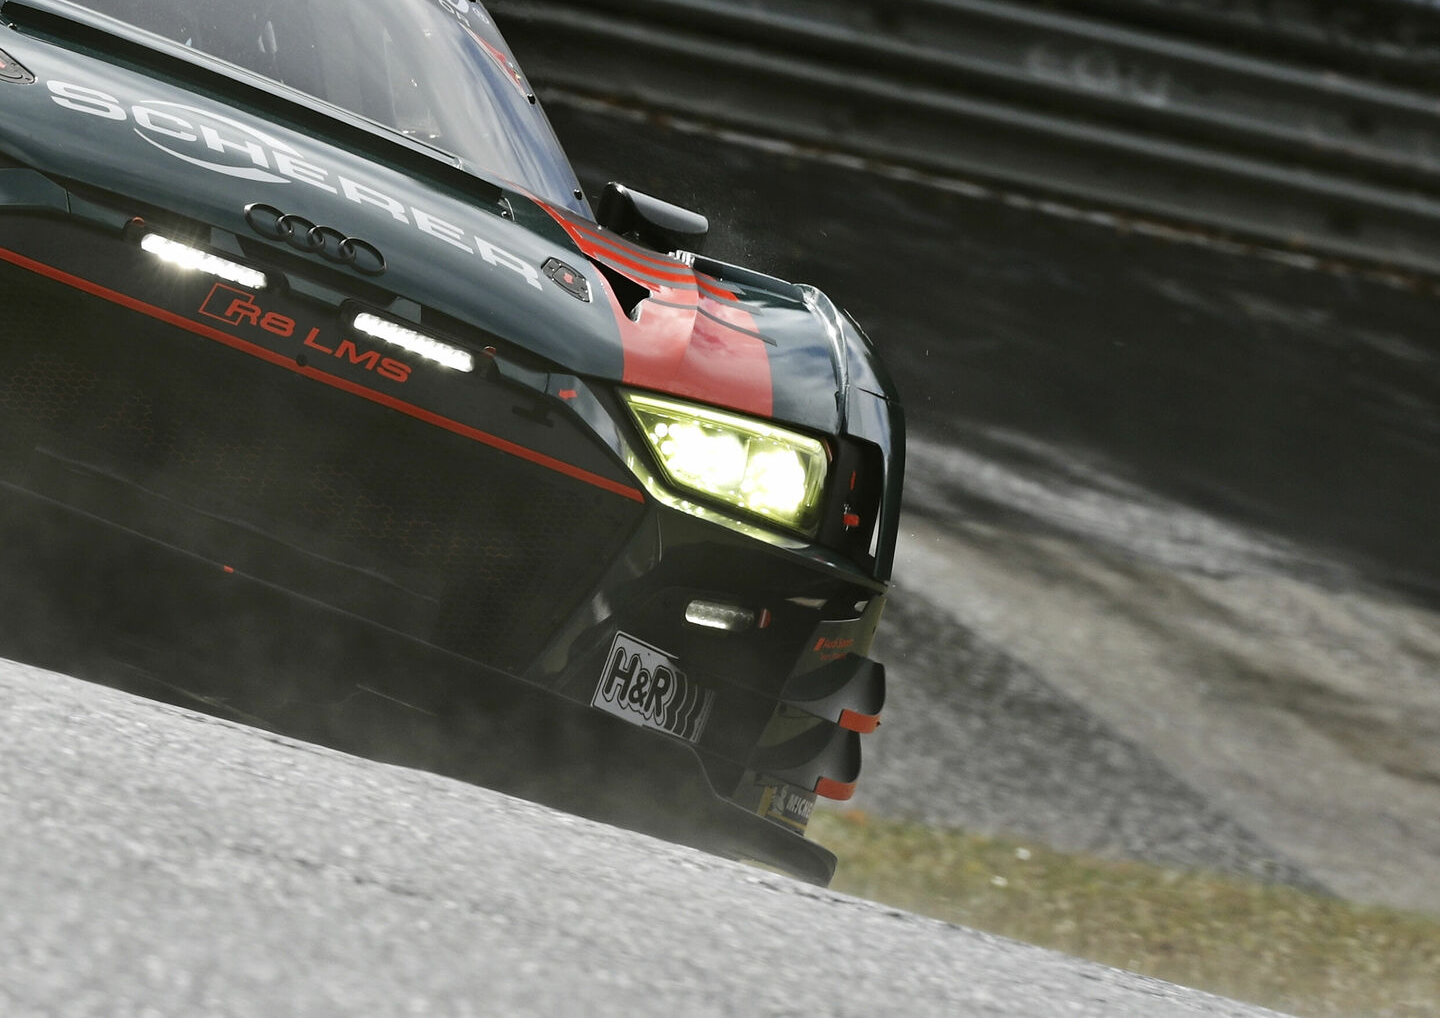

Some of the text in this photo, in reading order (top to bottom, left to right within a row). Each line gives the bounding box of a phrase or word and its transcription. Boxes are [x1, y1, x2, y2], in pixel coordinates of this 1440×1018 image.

[46, 78, 544, 291] SCHERER
[225, 296, 413, 383] R8 LMS
[603, 646, 677, 726] H&R
